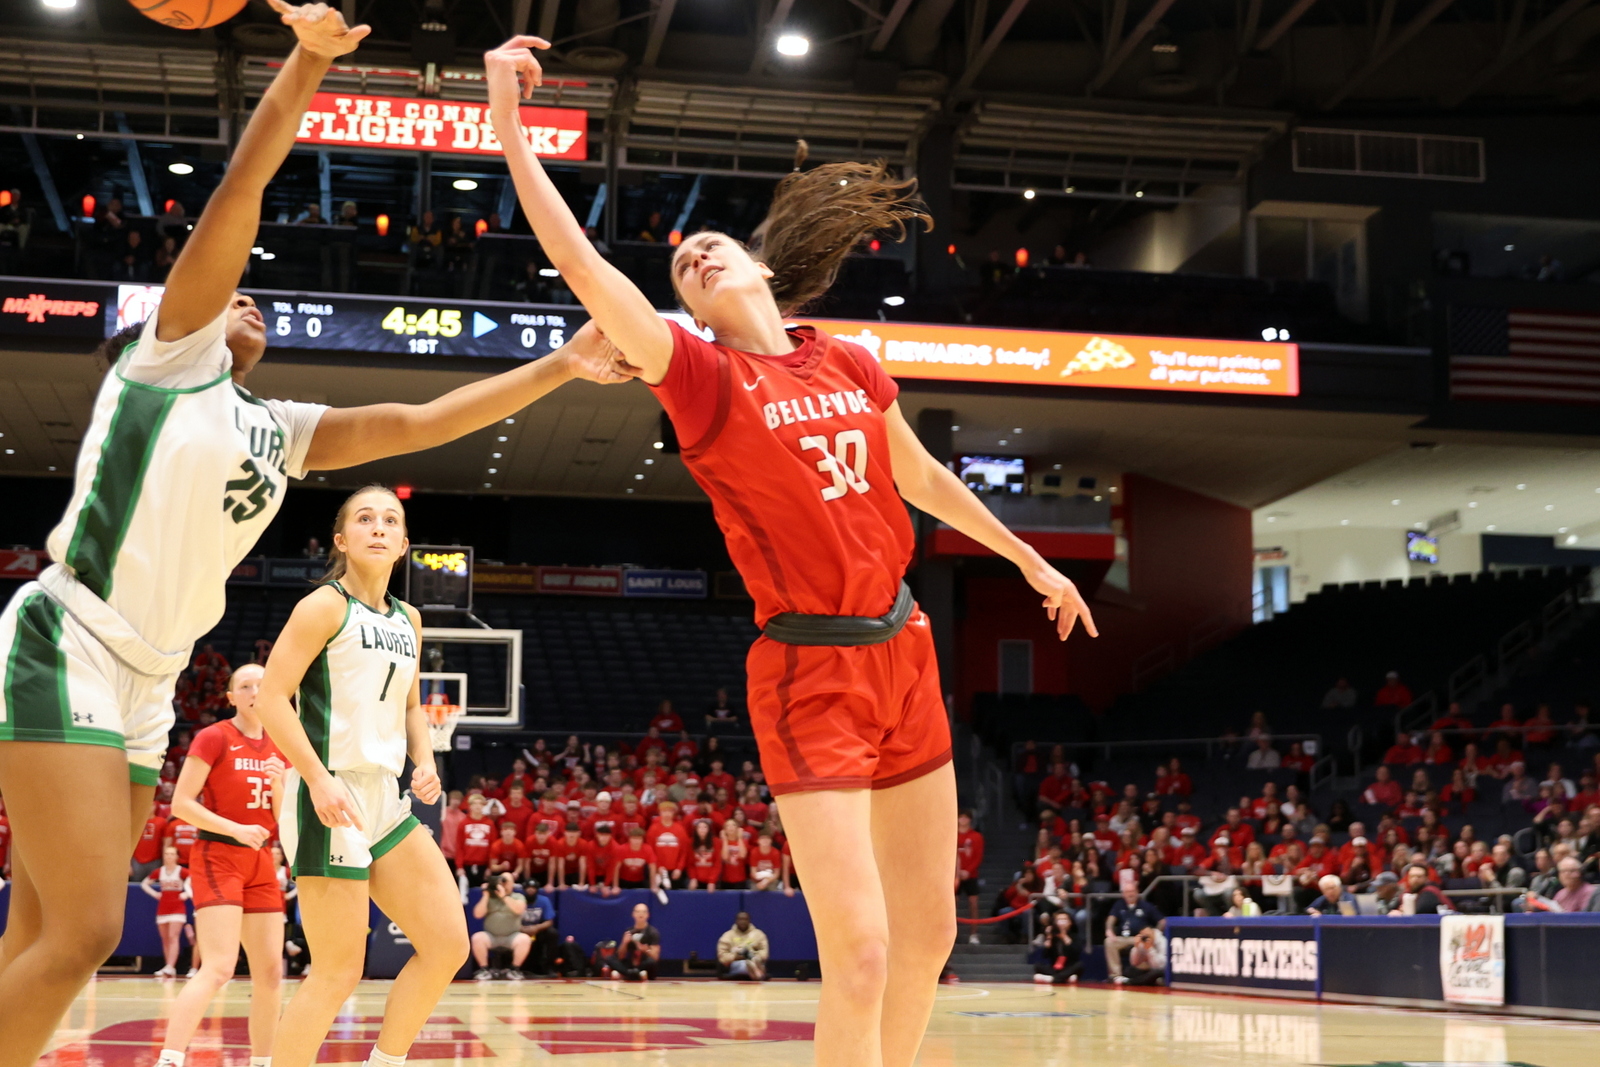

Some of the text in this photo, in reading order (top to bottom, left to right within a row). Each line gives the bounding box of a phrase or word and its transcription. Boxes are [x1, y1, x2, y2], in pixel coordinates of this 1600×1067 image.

[335, 98, 392, 116] THE
[297, 111, 558, 154] FLIGHT DEK
[2, 294, 99, 323] MAXPREPS
[273, 302, 333, 316] TOL FOULS
[381, 306, 462, 337] 4:45
[511, 313, 567, 328] FOULS TOL
[276, 315, 322, 338] 5 0
[520, 327, 565, 350] 0 5
[408, 338, 438, 354] 1ST
[885, 339, 993, 366] REWARDS
[995, 346, 1050, 370] today!
[1149, 350, 1188, 367] You'll
[1186, 355, 1218, 368] earn
[1218, 354, 1261, 371] points
[1168, 370, 1199, 384] your
[763, 389, 872, 430] BELLEVUE
[798, 429, 871, 502] 30
[223, 459, 277, 525] 25
[424, 552, 467, 573] 4:45
[627, 576, 704, 590] SAINT LOUIS
[360, 624, 417, 660] LAUREL
[379, 661, 397, 702] 1
[246, 776, 273, 810] 32
[1170, 937, 1319, 982] DAYTON FLYERS
